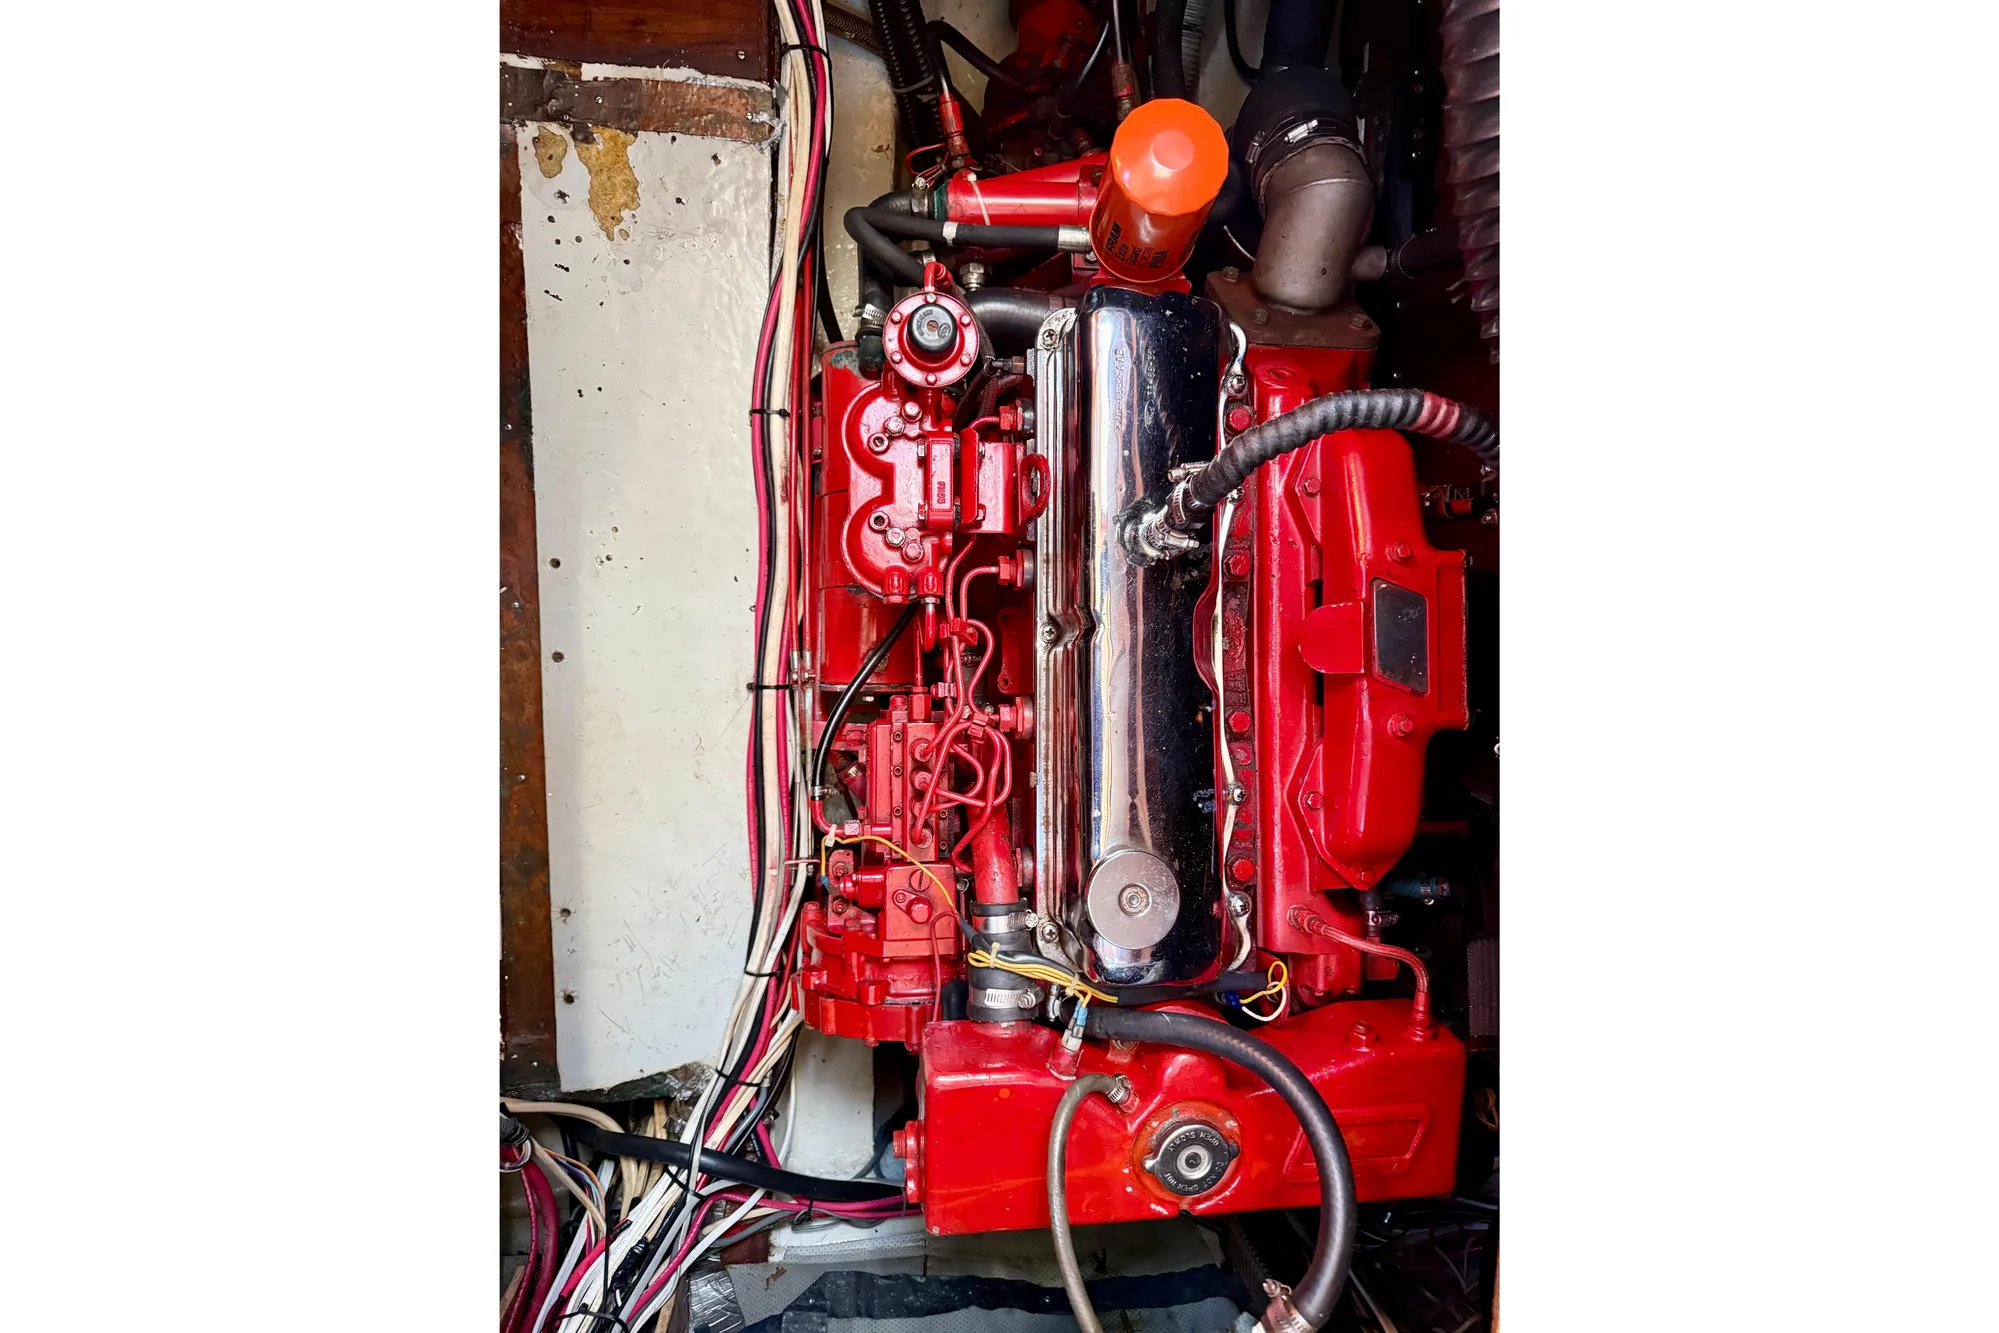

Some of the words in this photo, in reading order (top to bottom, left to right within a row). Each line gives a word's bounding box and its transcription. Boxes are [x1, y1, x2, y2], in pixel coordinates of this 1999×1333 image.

[1105, 220, 1123, 254] FRAM
[1114, 243, 1129, 262] Extra
[1125, 244, 1142, 266] Guard
[1167, 1131, 1196, 1152] SLOWLY
[1199, 1131, 1219, 1146] OPEN
[1215, 1161, 1224, 1172] DO
[1164, 1172, 1178, 1186] HOT
[1202, 1173, 1217, 1188] NOT
[1177, 1182, 1199, 1192] OPEN
